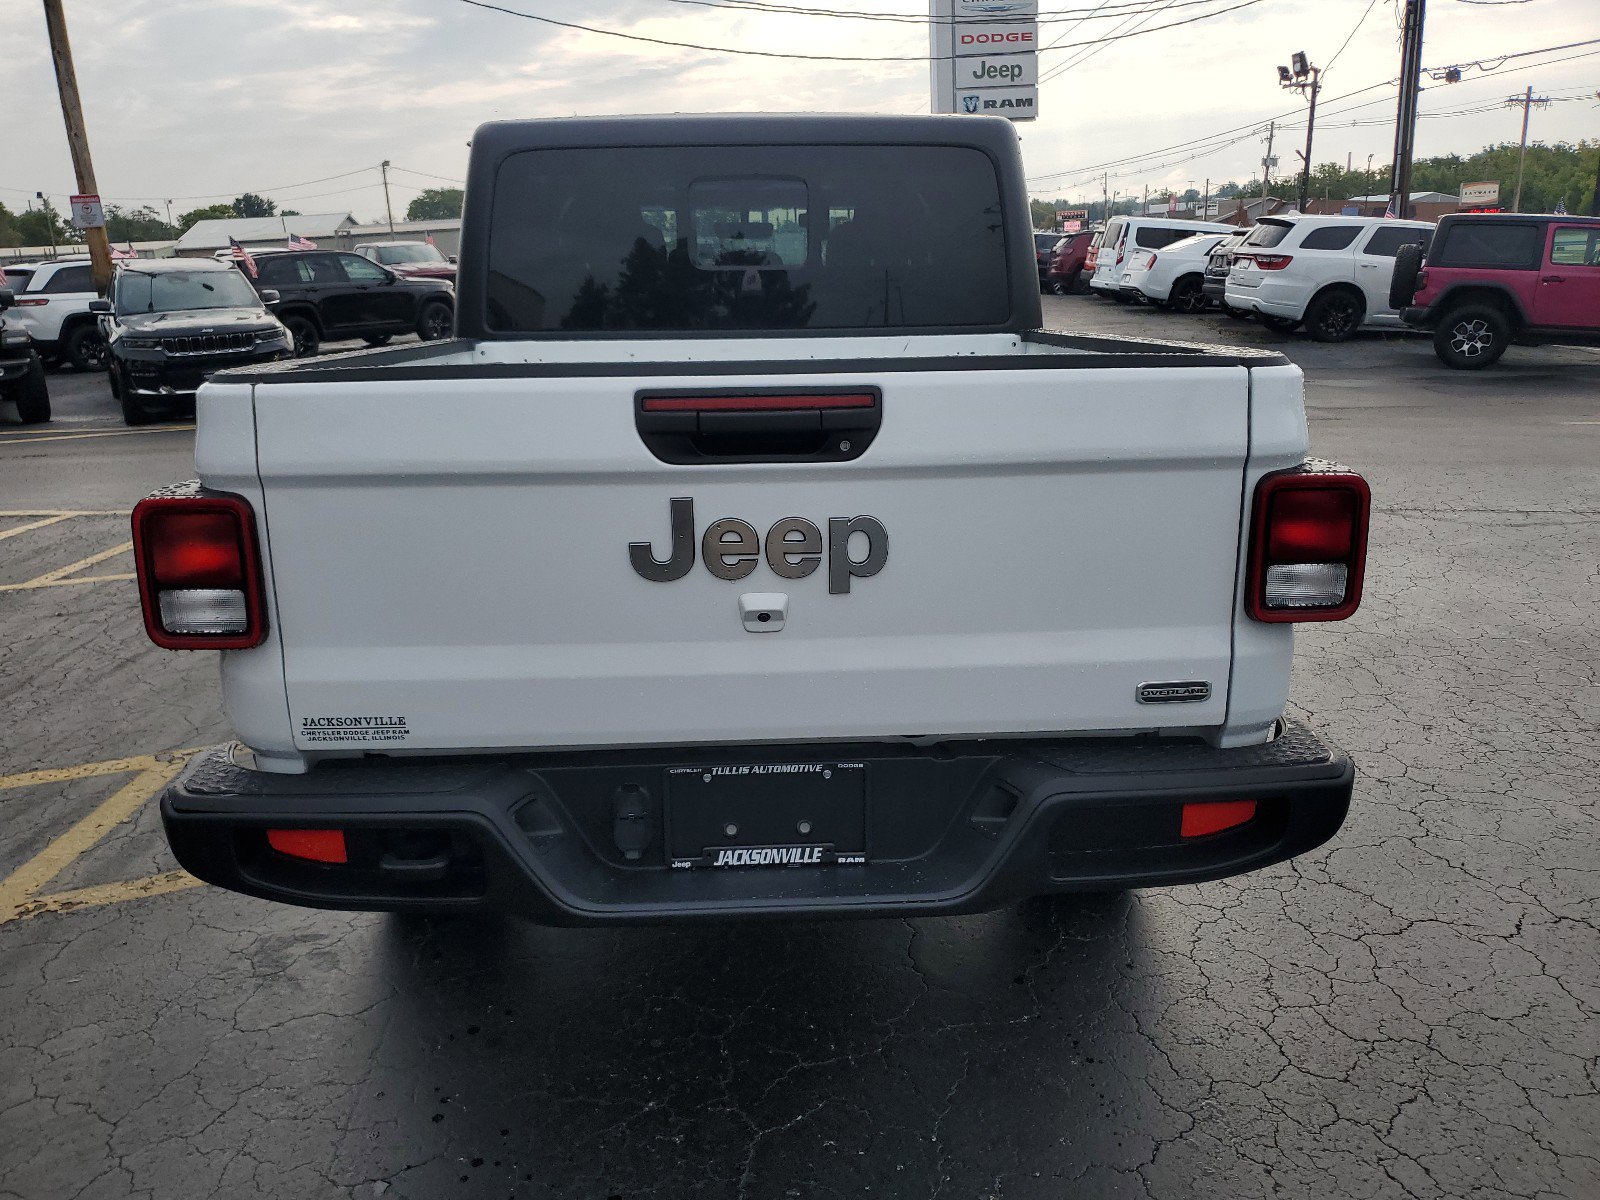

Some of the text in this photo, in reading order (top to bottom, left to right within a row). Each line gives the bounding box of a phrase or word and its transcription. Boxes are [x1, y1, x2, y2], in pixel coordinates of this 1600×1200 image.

[961, 32, 1033, 44] DODGE
[972, 60, 1023, 82] Jeep
[983, 98, 1033, 109] RAM
[628, 496, 889, 594] Jeep
[1140, 688, 1209, 697] OVERLAND
[302, 716, 406, 727] JACKSONVILLE
[711, 764, 823, 776] TULLIS AUTOMOTIVE
[713, 847, 823, 866] JACKSONVILLE
[671, 860, 691, 869] Jeep
